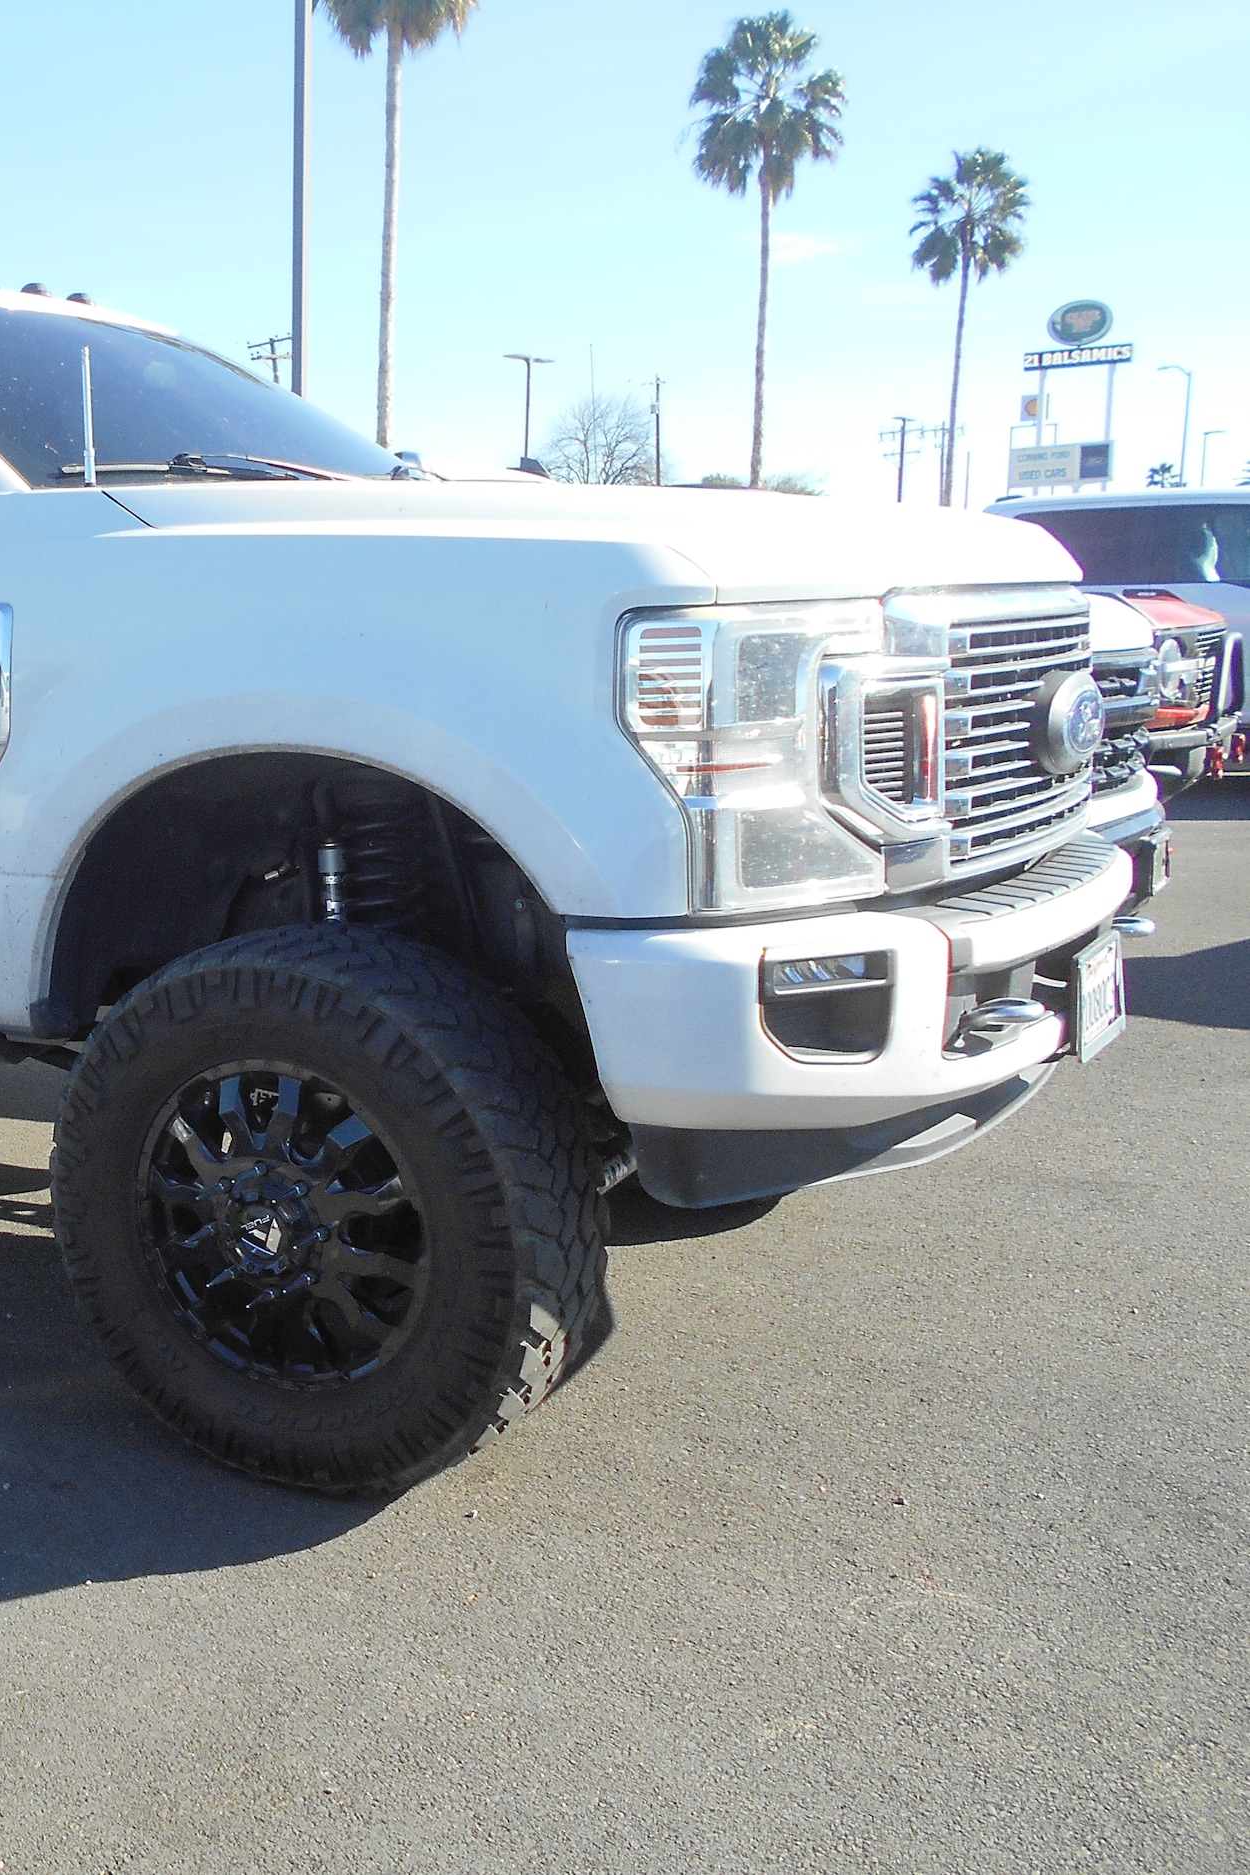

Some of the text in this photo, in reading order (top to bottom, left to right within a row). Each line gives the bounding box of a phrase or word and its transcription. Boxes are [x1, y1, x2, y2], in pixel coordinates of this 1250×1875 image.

[1041, 346, 1131, 366] BALSAMICS
[1018, 450, 1070, 462] CORNING FORD
[1019, 468, 1067, 480] USED CARS
[240, 1214, 271, 1231] FUEL
